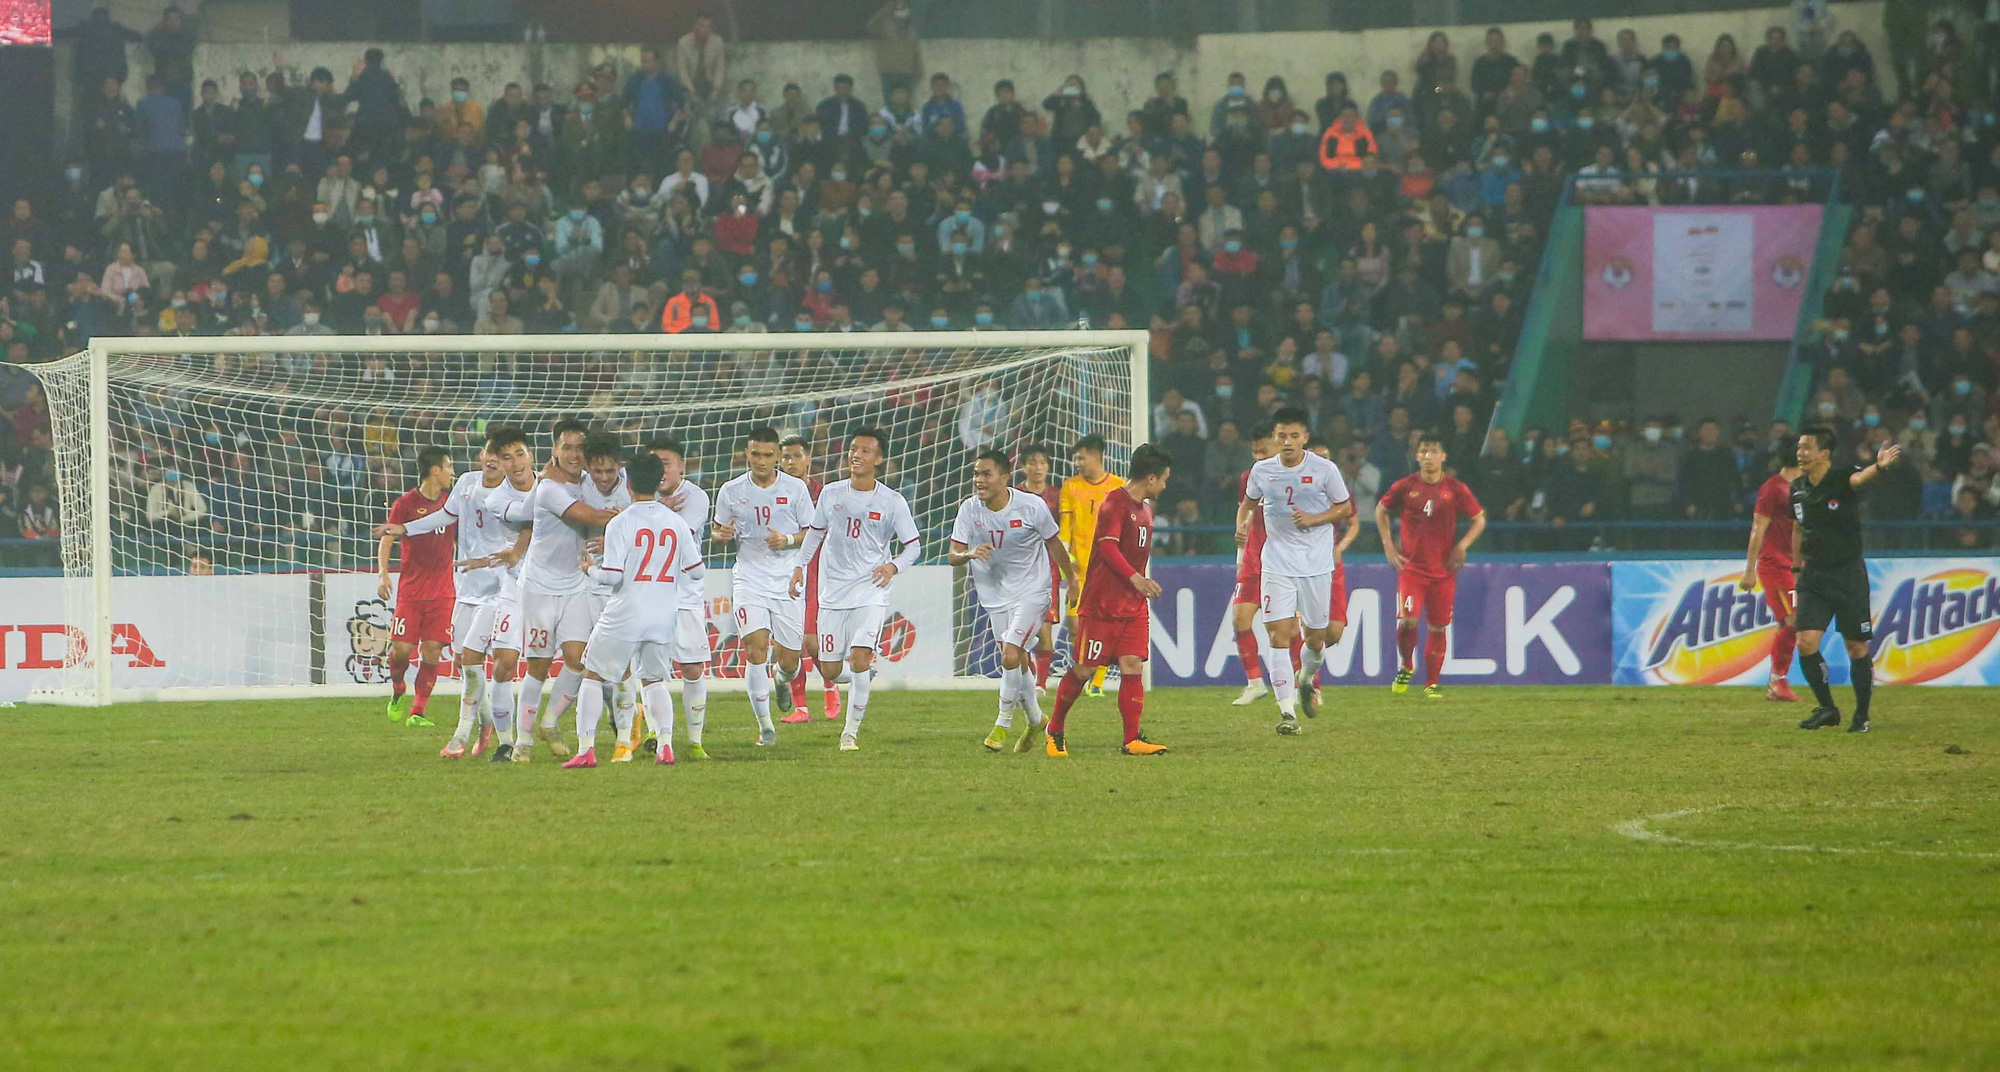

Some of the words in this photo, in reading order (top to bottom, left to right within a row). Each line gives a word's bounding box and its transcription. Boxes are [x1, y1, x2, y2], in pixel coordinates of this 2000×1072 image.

[1285, 486, 1295, 505] 2
[754, 506, 771, 526] 19
[1423, 499, 1433, 516] 4
[476, 509, 484, 528] 3
[846, 517, 861, 539] 18
[988, 530, 1005, 550] 17
[1138, 526, 1147, 548] 19
[633, 528, 678, 583] 22
[1264, 595, 1271, 613] 2
[1404, 595, 1413, 612] 4
[394, 617, 406, 636] 16
[500, 614, 511, 633] 6
[734, 607, 747, 628] 19
[1646, 579, 1776, 667] Attac
[1868, 576, 2000, 659] Attack
[0, 624, 166, 669] DA
[529, 628, 548, 649] 23
[821, 634, 834, 652] 18
[1087, 639, 1103, 660] 19
